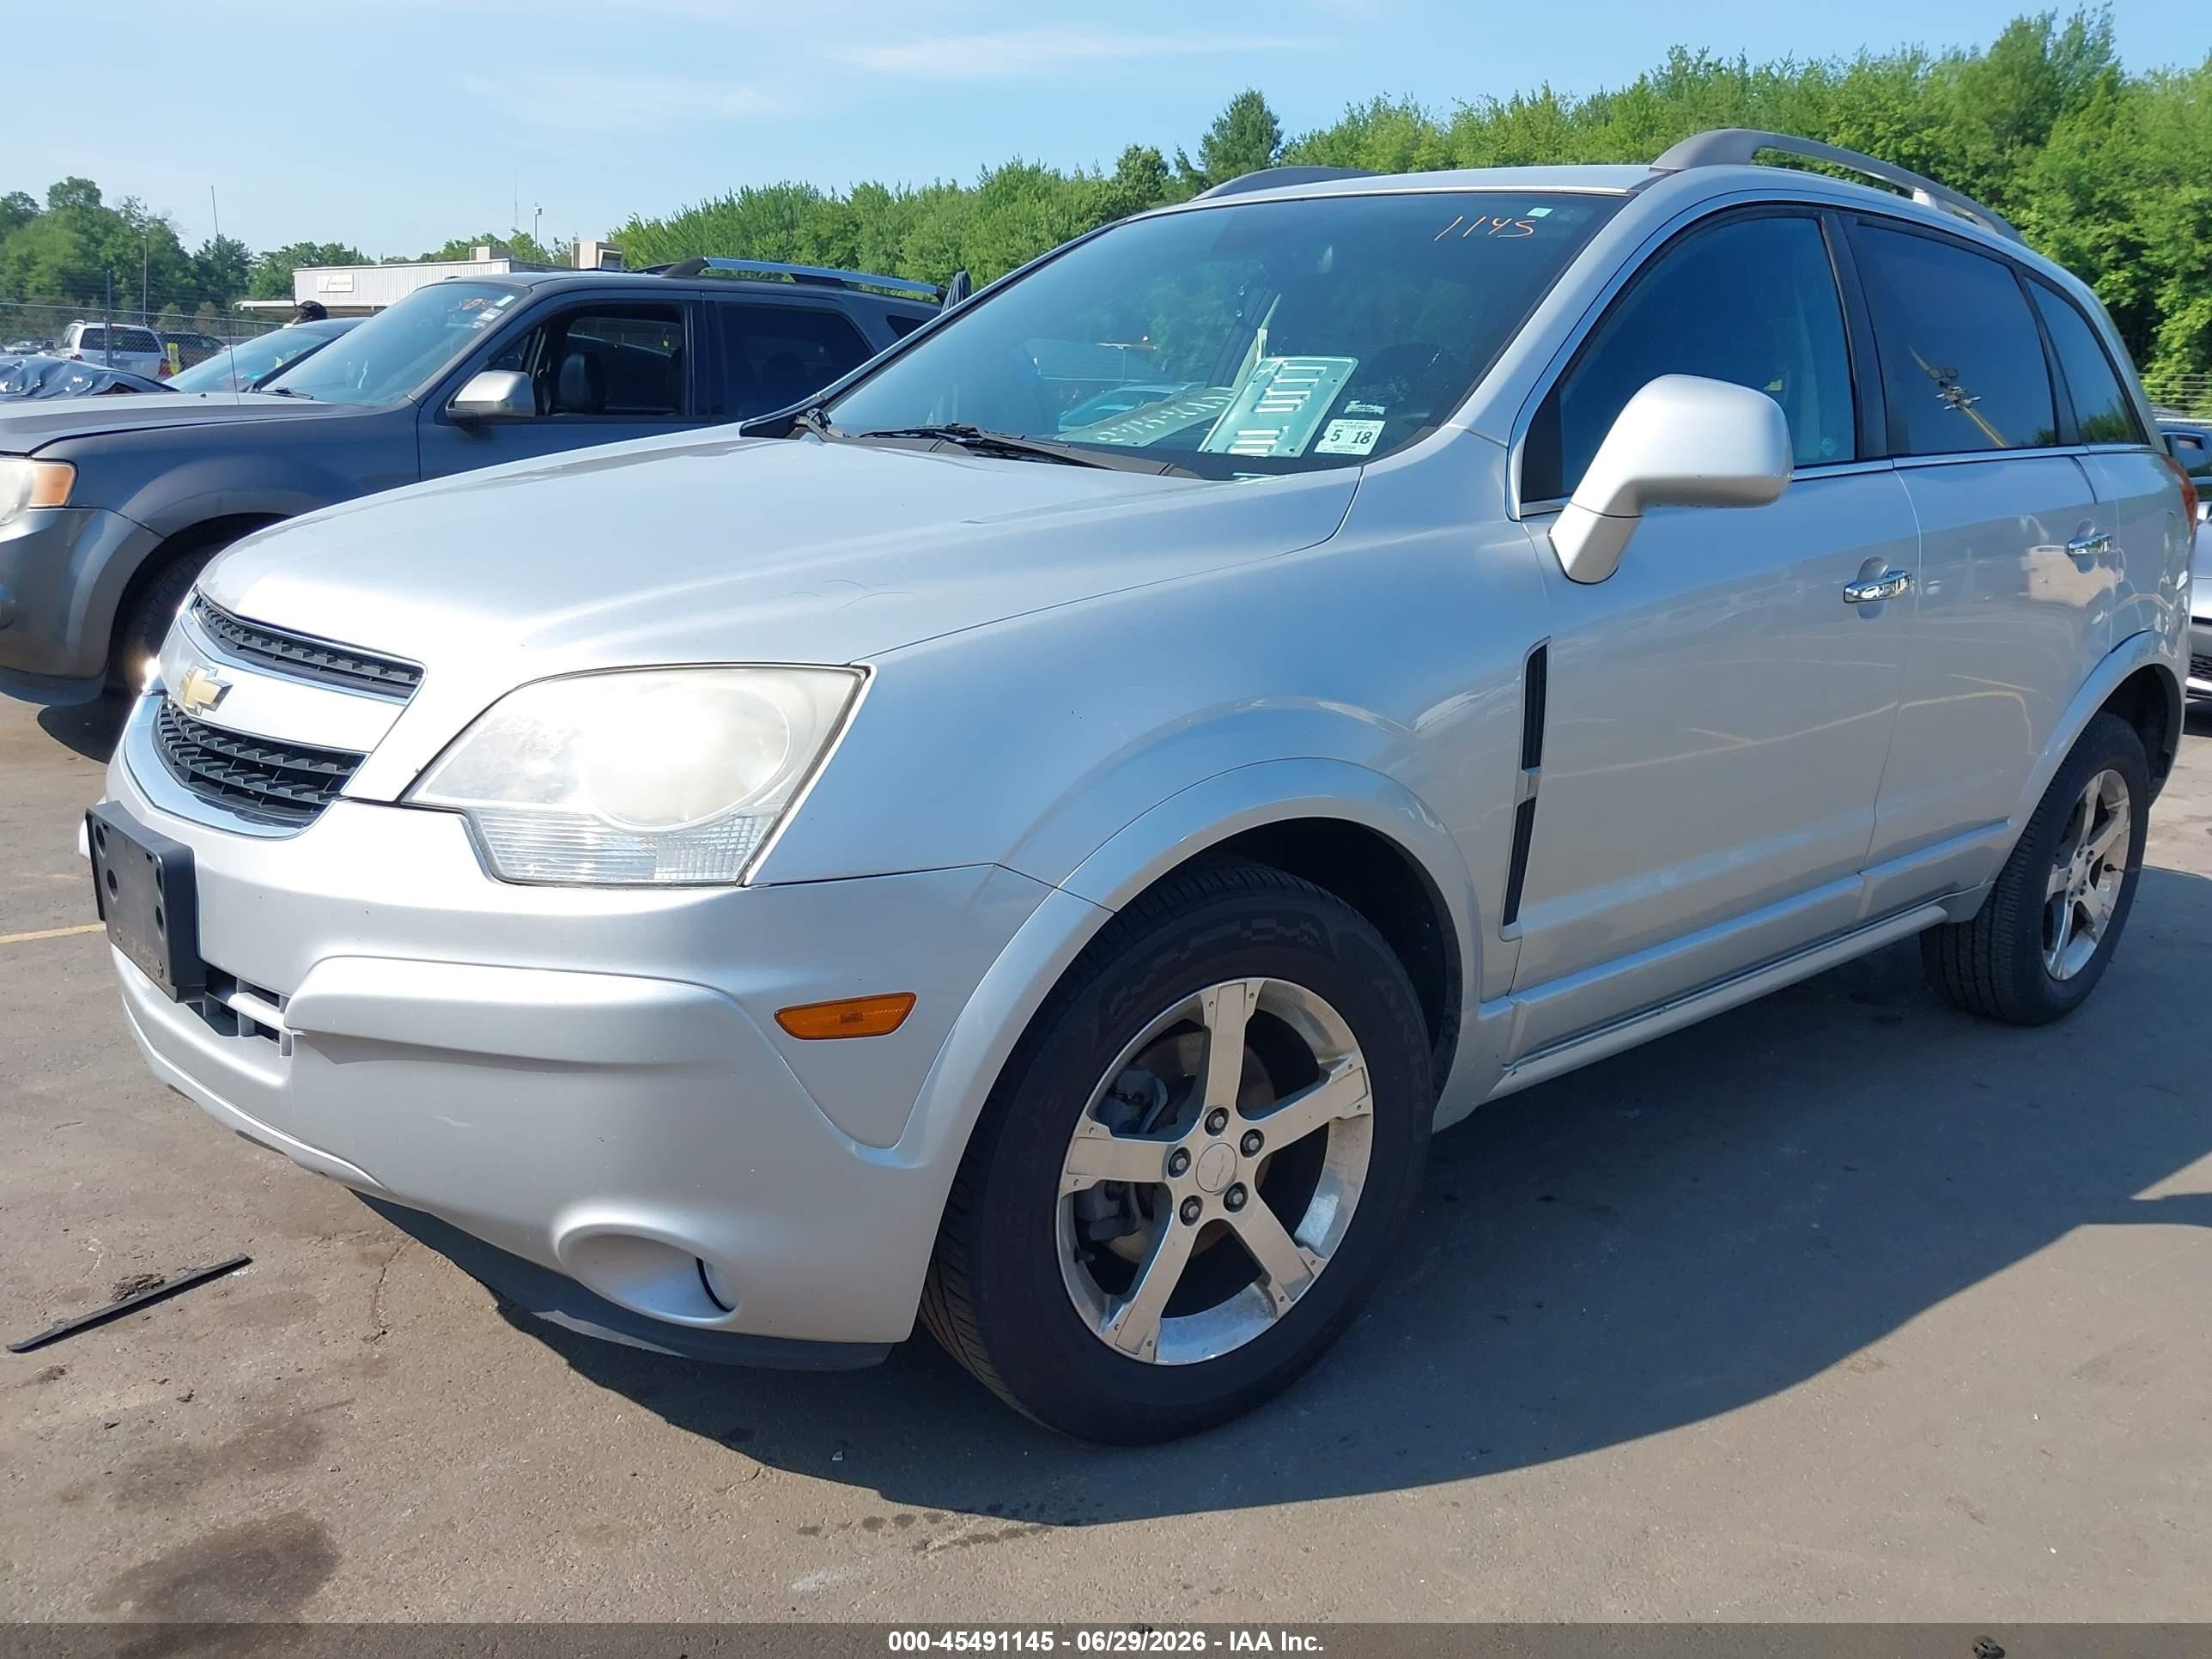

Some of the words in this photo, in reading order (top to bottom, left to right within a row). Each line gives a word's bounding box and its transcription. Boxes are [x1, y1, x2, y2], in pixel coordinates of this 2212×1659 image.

[1433, 215, 1537, 242] 1145
[1329, 429, 1343, 442] 5
[1351, 430, 1373, 445] 18
